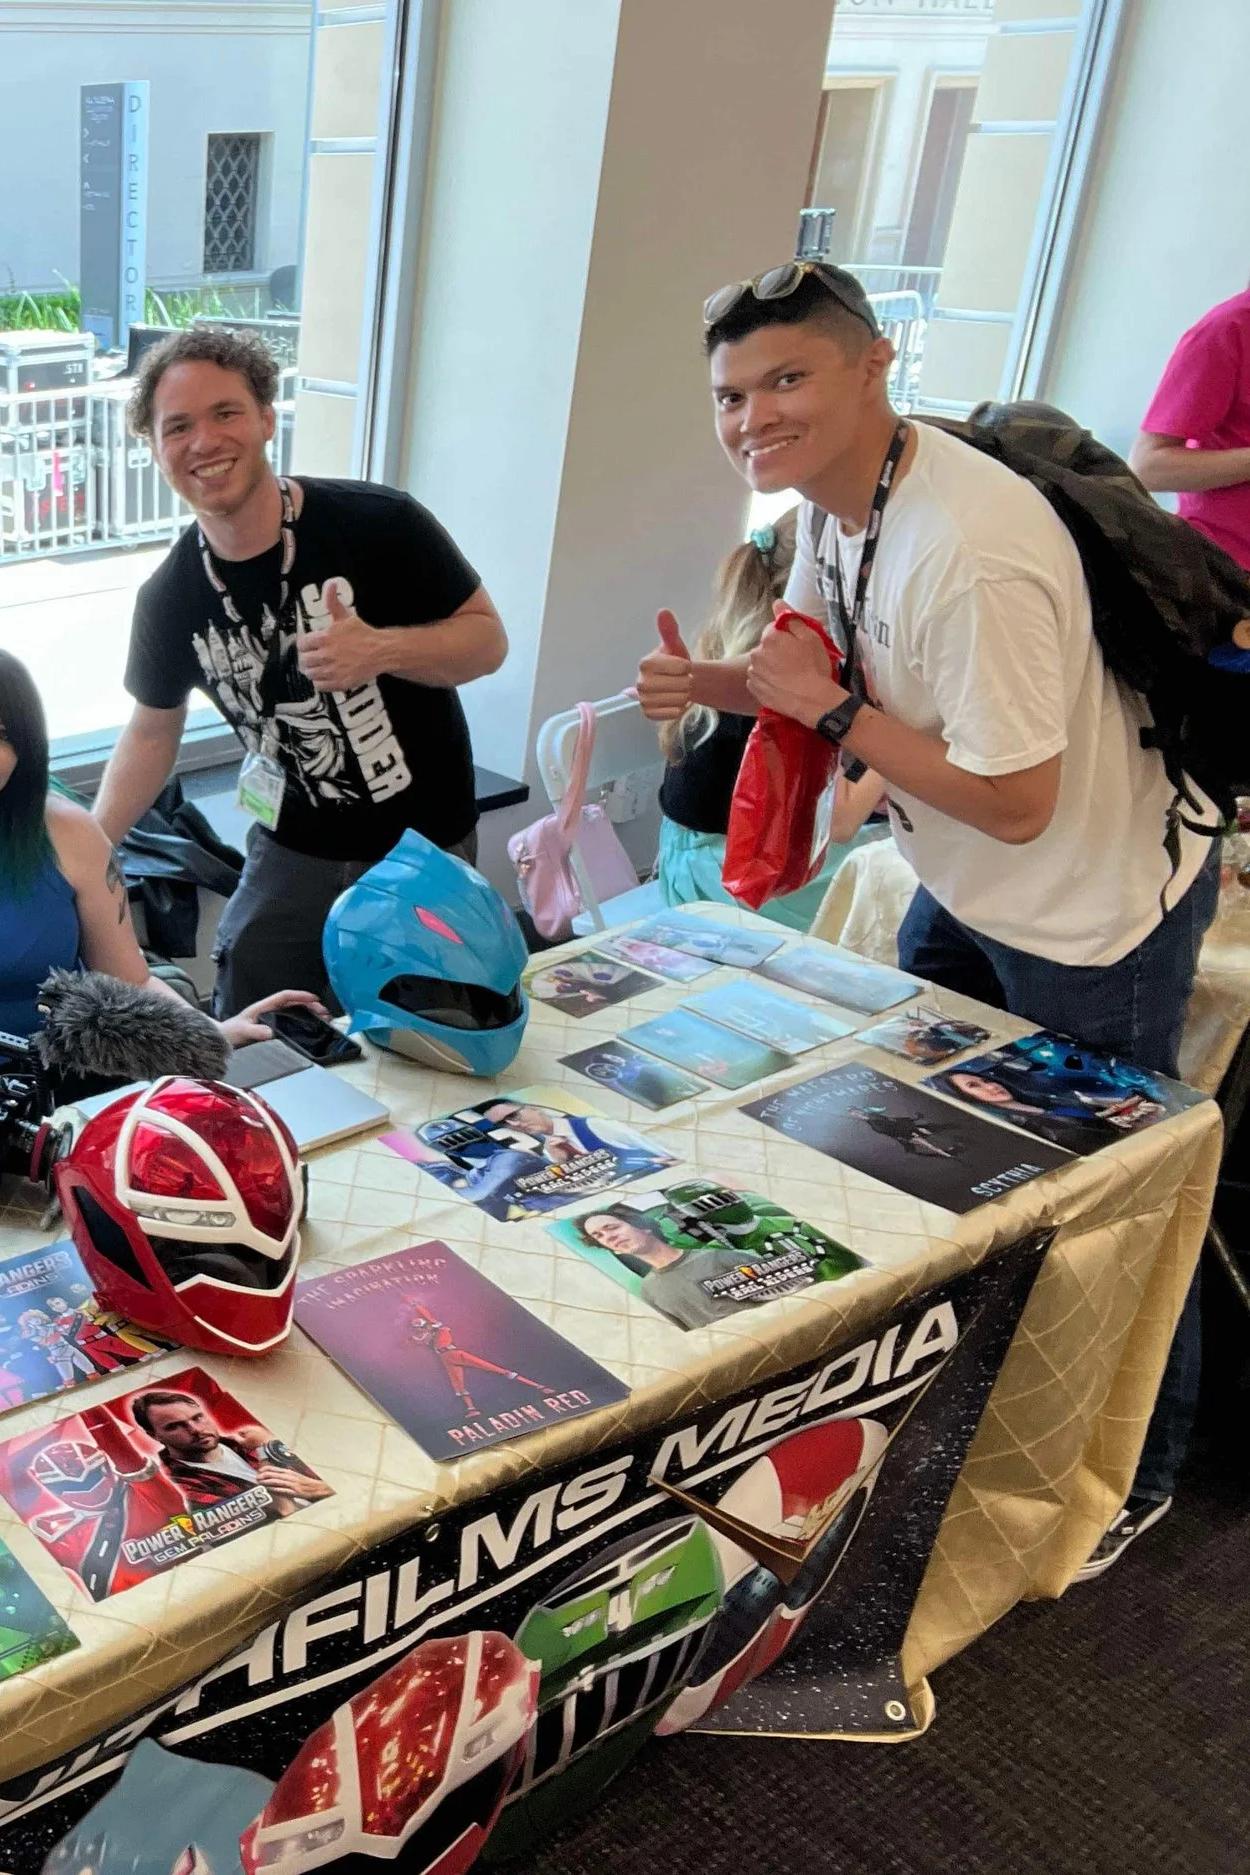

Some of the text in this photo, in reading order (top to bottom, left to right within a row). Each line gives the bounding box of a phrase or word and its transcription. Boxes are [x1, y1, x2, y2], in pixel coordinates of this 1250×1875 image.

[125, 95, 142, 313] DIRECTOR
[970, 1163, 1045, 1197] SCYTHIA
[702, 1250, 808, 1294] POWER RANGERS
[447, 1390, 591, 1446] PALADIN RED
[646, 1301, 958, 1488] MEDIA
[126, 1488, 268, 1561] POWER RANGERS
[154, 1510, 262, 1562] GEM PALADINS
